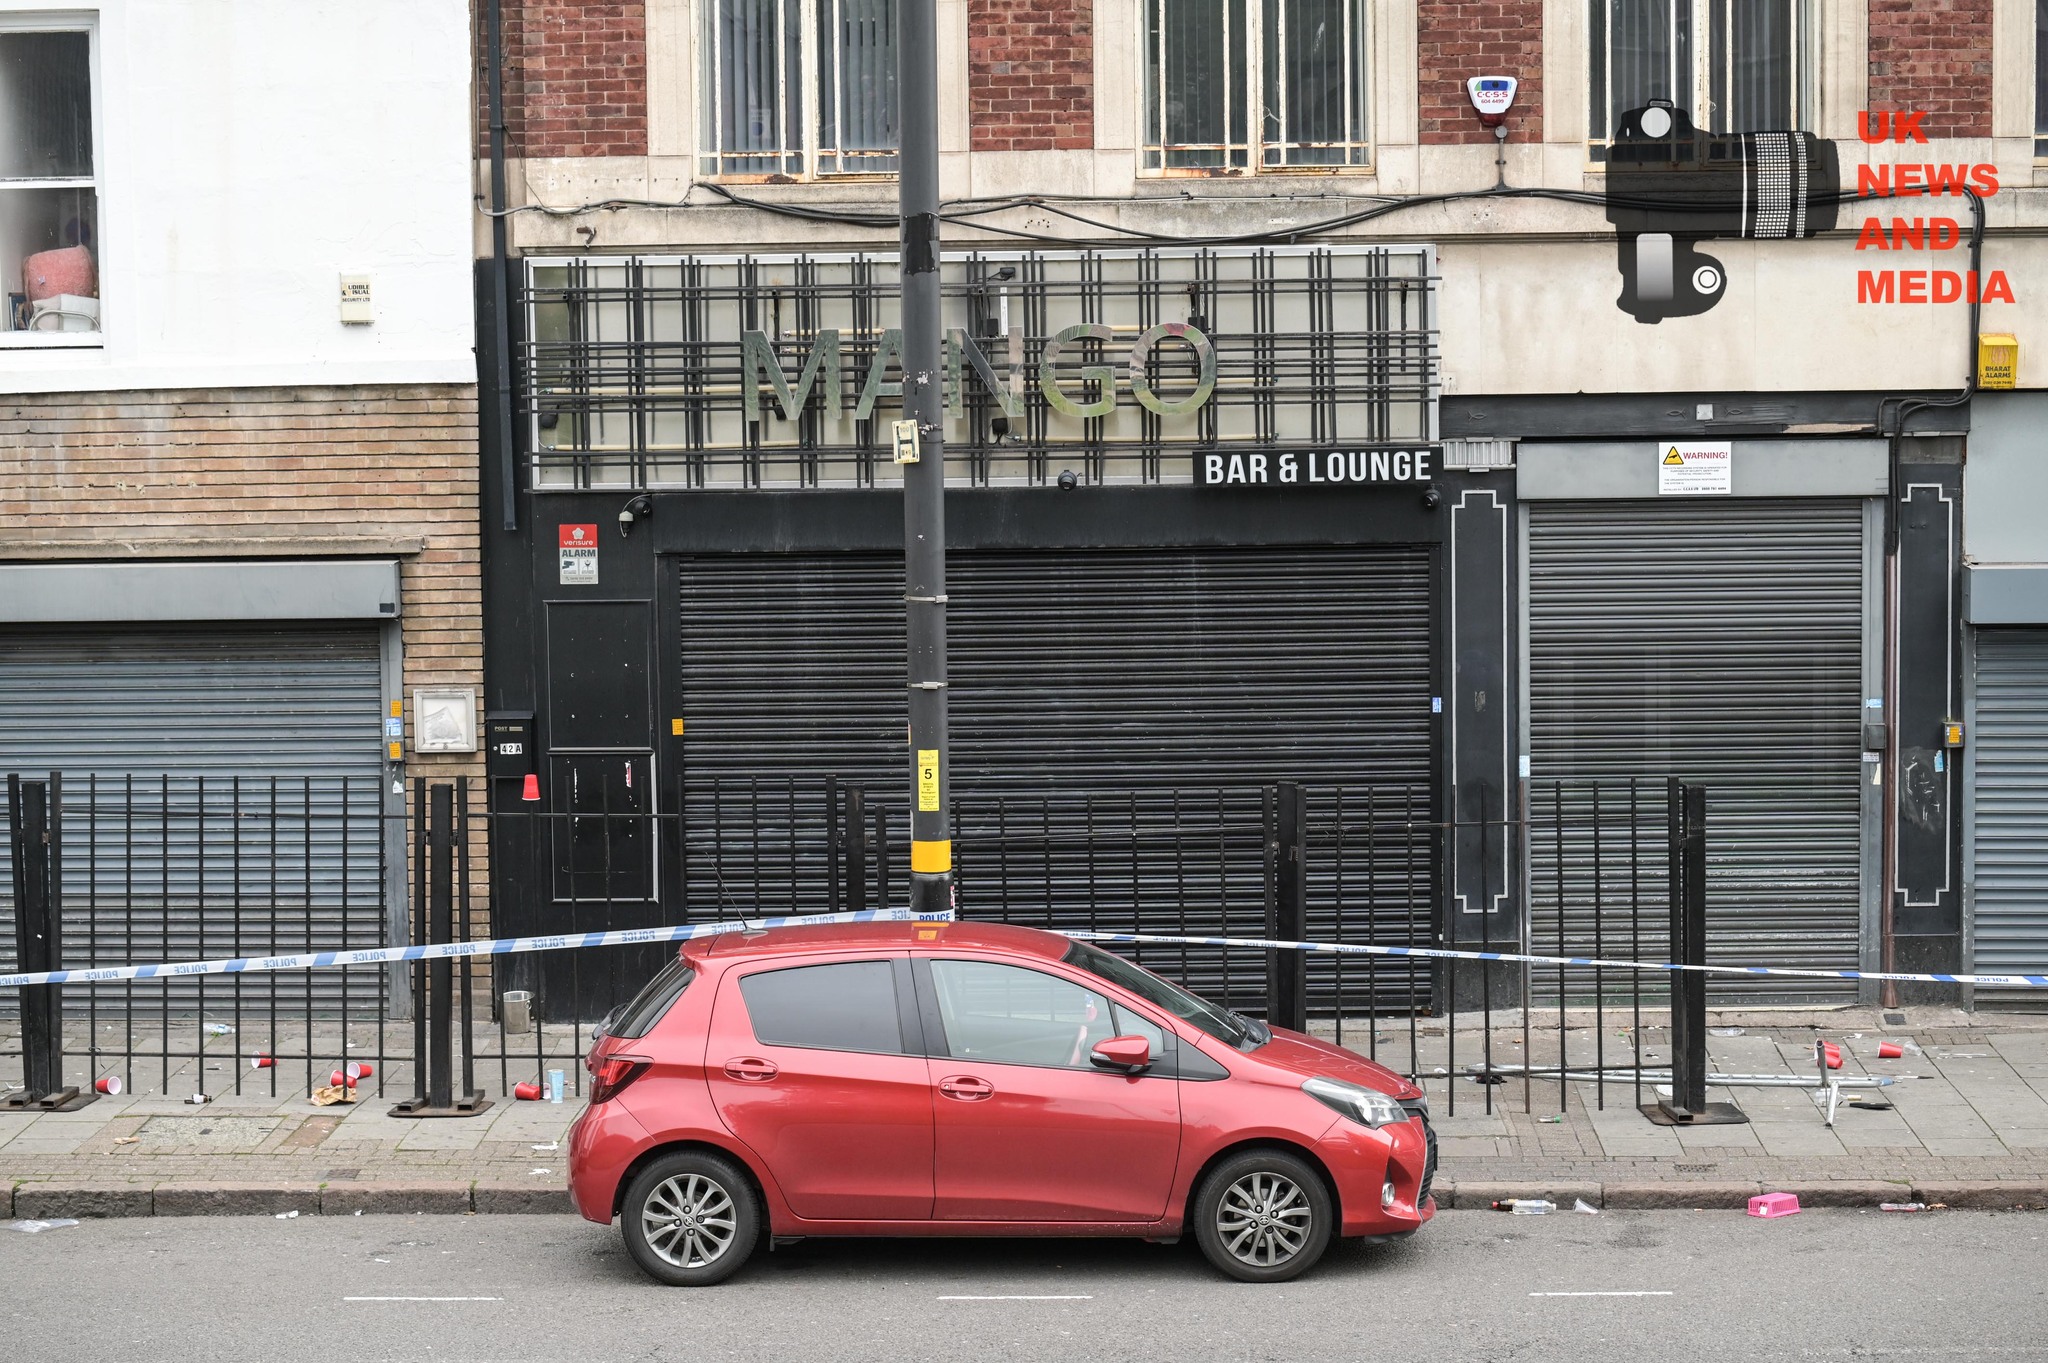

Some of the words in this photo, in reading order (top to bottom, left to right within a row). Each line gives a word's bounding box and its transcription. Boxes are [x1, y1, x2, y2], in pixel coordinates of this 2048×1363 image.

[744, 322, 1216, 420] MANGO
[1205, 454, 1268, 484] BAR
[1279, 453, 1298, 483] &
[1308, 451, 1431, 482] LOUNGE
[562, 549, 596, 557] ALARM
[502, 744, 522, 753] 42A
[925, 769, 932, 779] 5
[920, 913, 950, 921] POLICE
